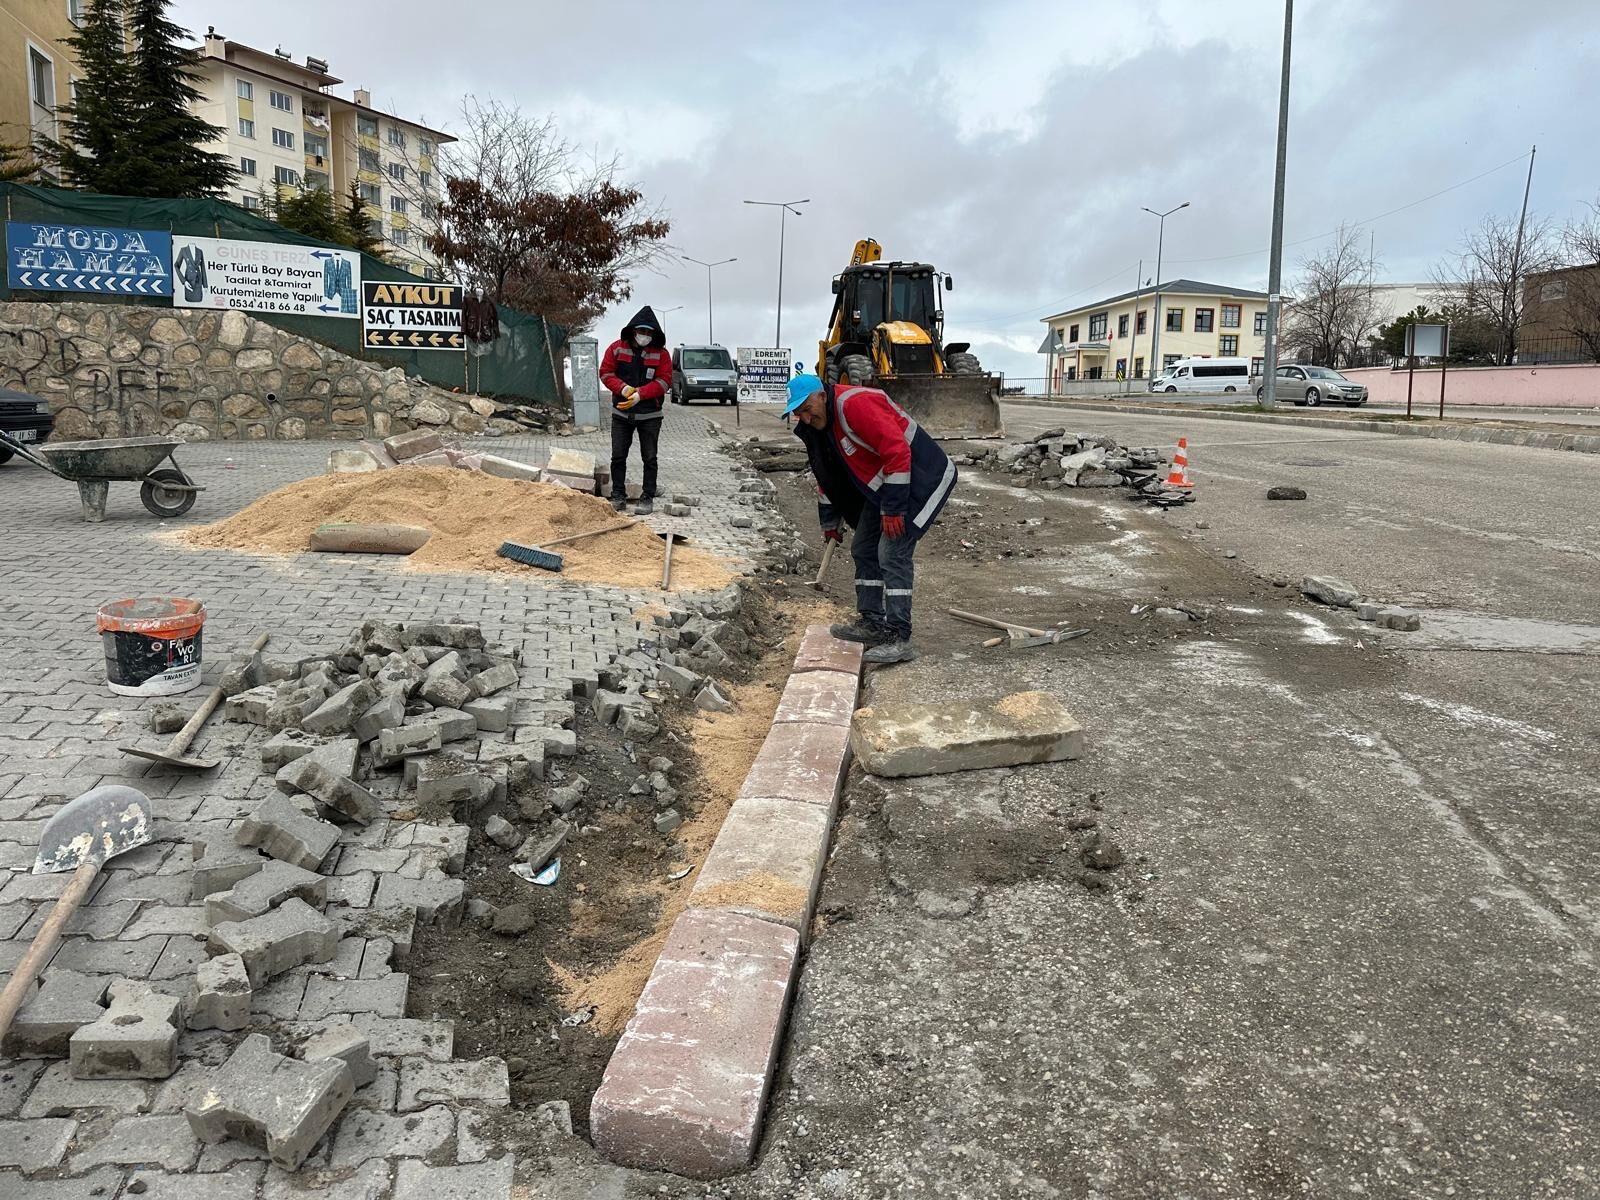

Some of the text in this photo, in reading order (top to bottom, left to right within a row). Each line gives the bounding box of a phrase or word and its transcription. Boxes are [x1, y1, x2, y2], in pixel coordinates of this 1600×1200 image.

[31, 225, 150, 253] MODA
[14, 246, 169, 277] HAMZA
[207, 260, 323, 281] Her Türlü Bay Bayan
[224, 275, 262, 286] Tadilat
[210, 285, 324, 304] Kurutemizleme Yapılır
[372, 284, 455, 306] AYKUT
[229, 298, 306, 312] 0534 418 66 48
[367, 308, 462, 329] SAÇ TASARIM
[755, 350, 787, 358] EDREMİT
[177, 644, 195, 657] WO
[183, 653, 192, 664] RI
[163, 672, 183, 681] TAVAN
